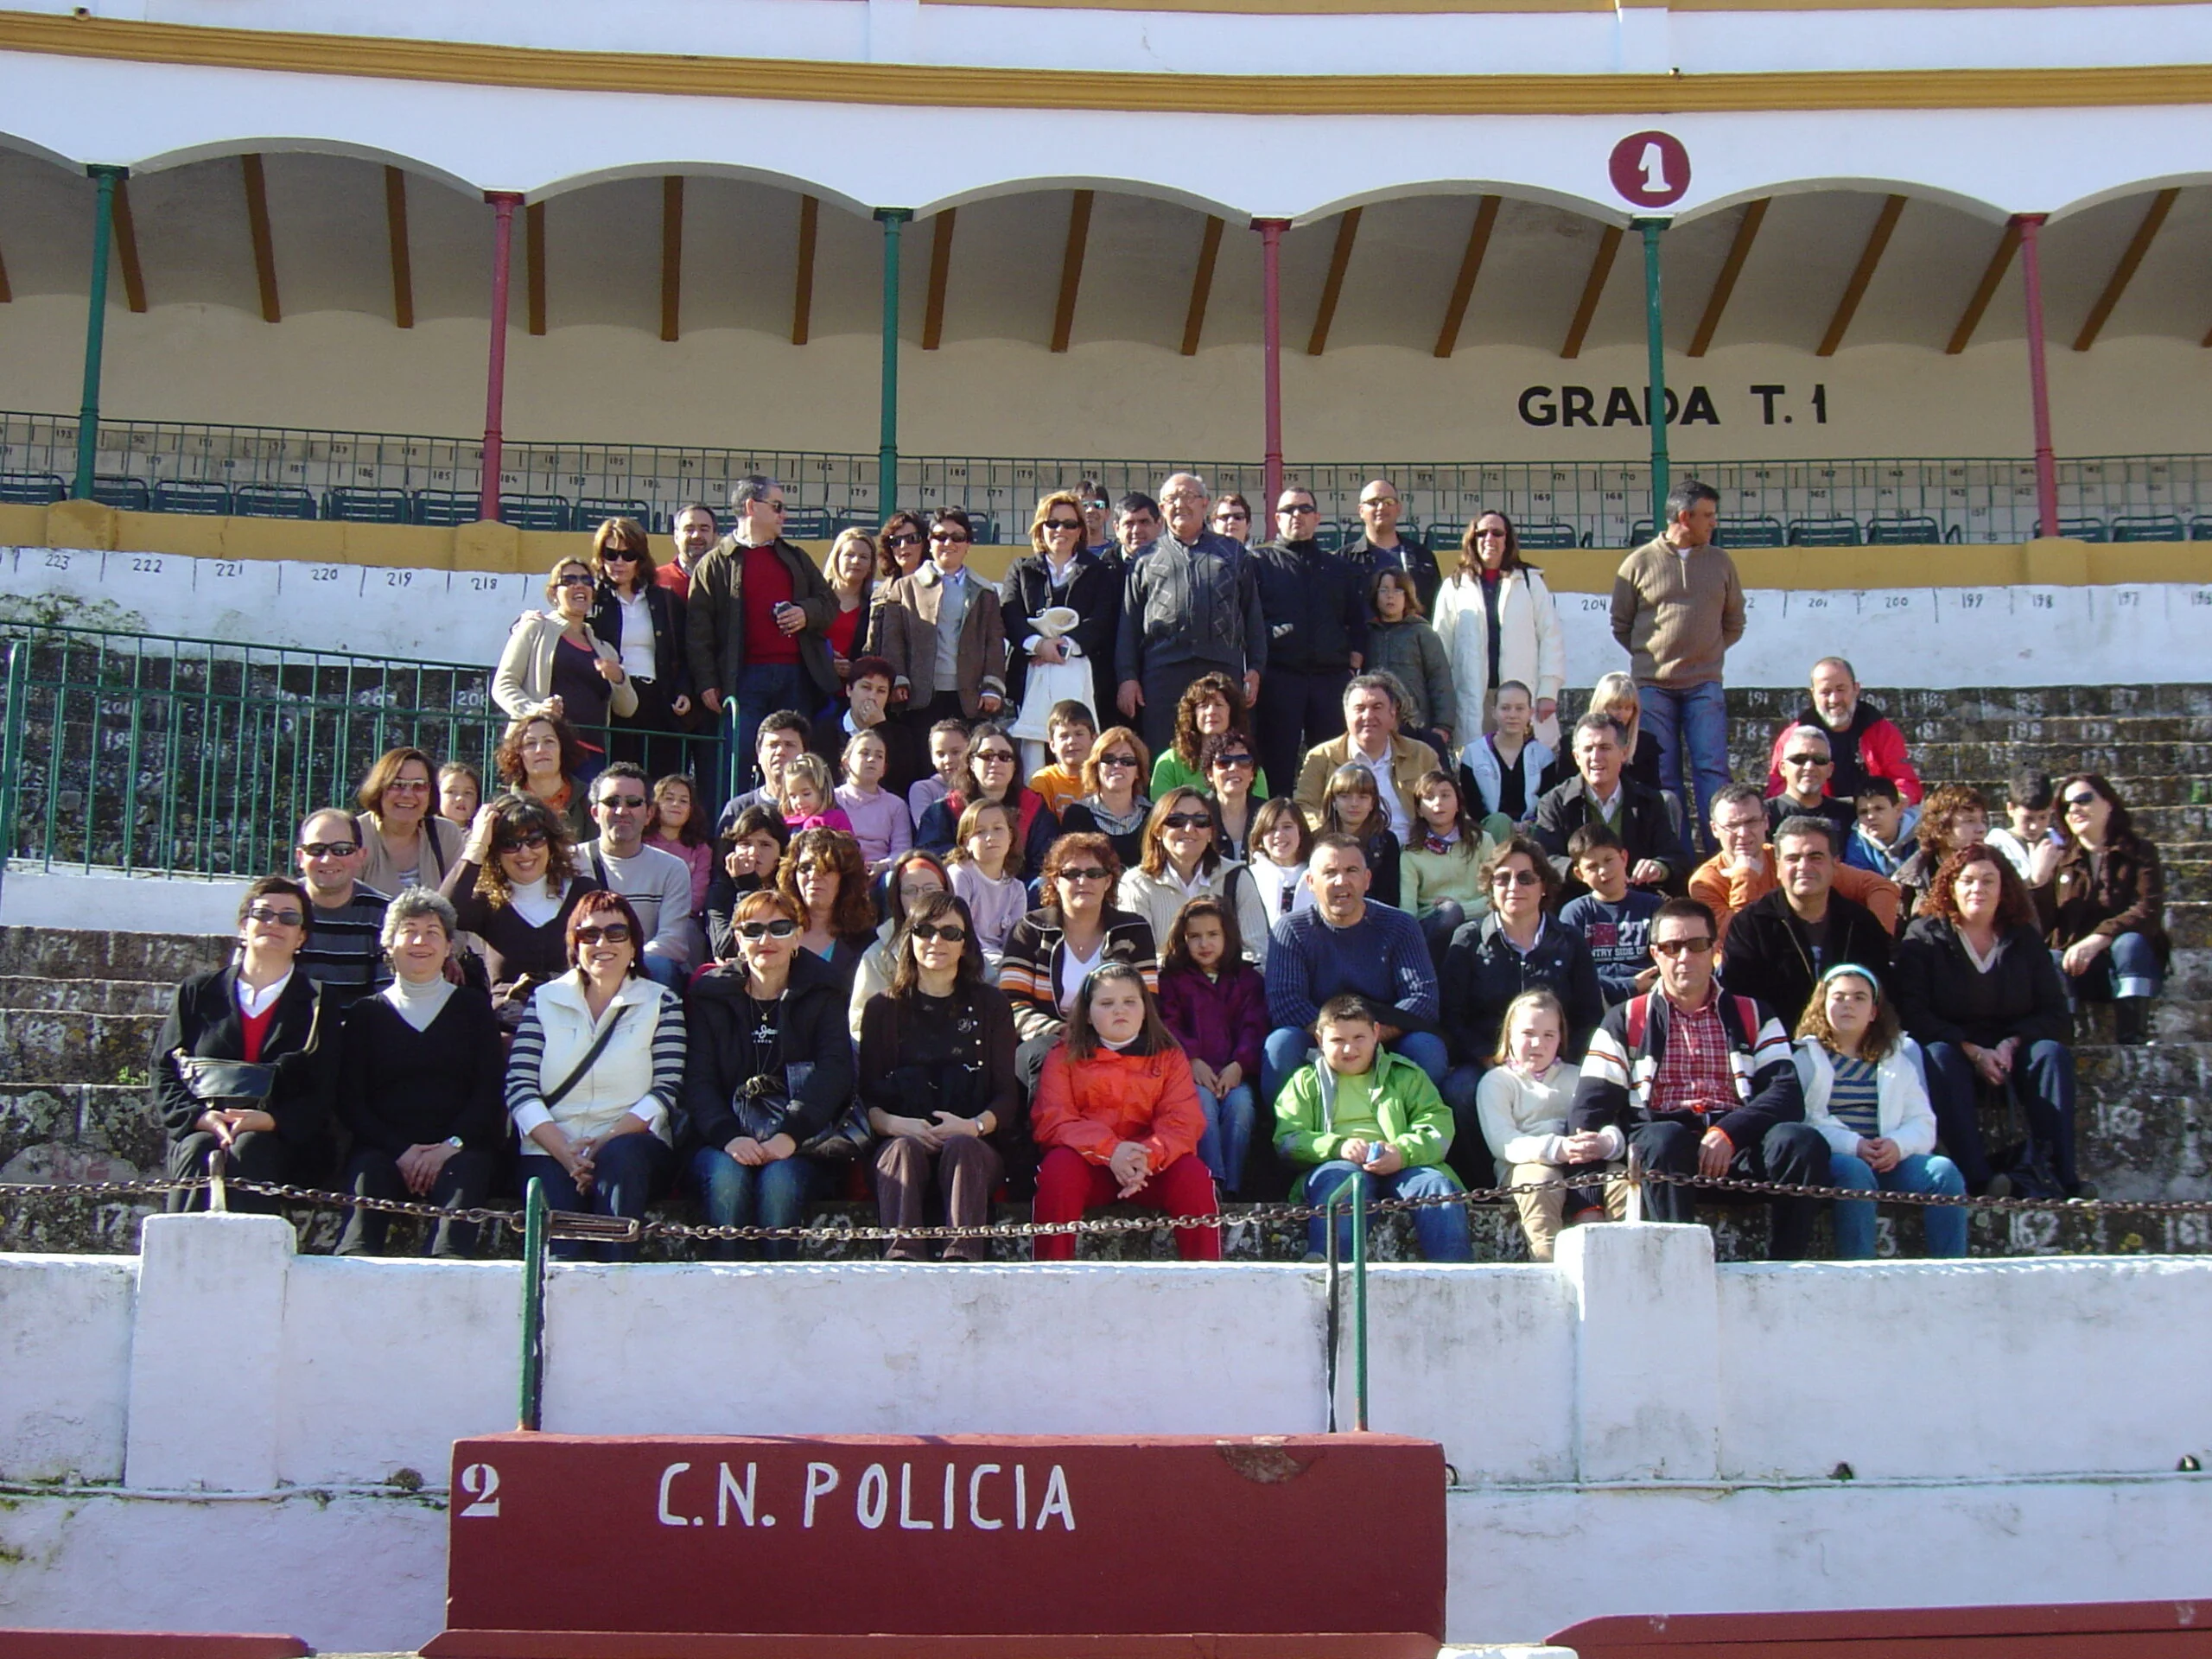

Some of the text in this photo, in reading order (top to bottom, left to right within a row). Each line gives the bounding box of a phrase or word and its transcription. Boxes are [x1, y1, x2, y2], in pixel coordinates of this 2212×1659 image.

[1638, 142, 1672, 193] 1
[1518, 385, 1720, 427] GRADA
[45, 554, 71, 570] 223
[132, 558, 163, 573] 222
[216, 563, 244, 577] 221
[311, 568, 339, 581] 220
[387, 572, 412, 587] 219
[471, 577, 498, 590] 218
[1582, 600, 1607, 611] 204
[460, 1463, 500, 1518] 2
[658, 1461, 1076, 1531] C.N. POLICIA
